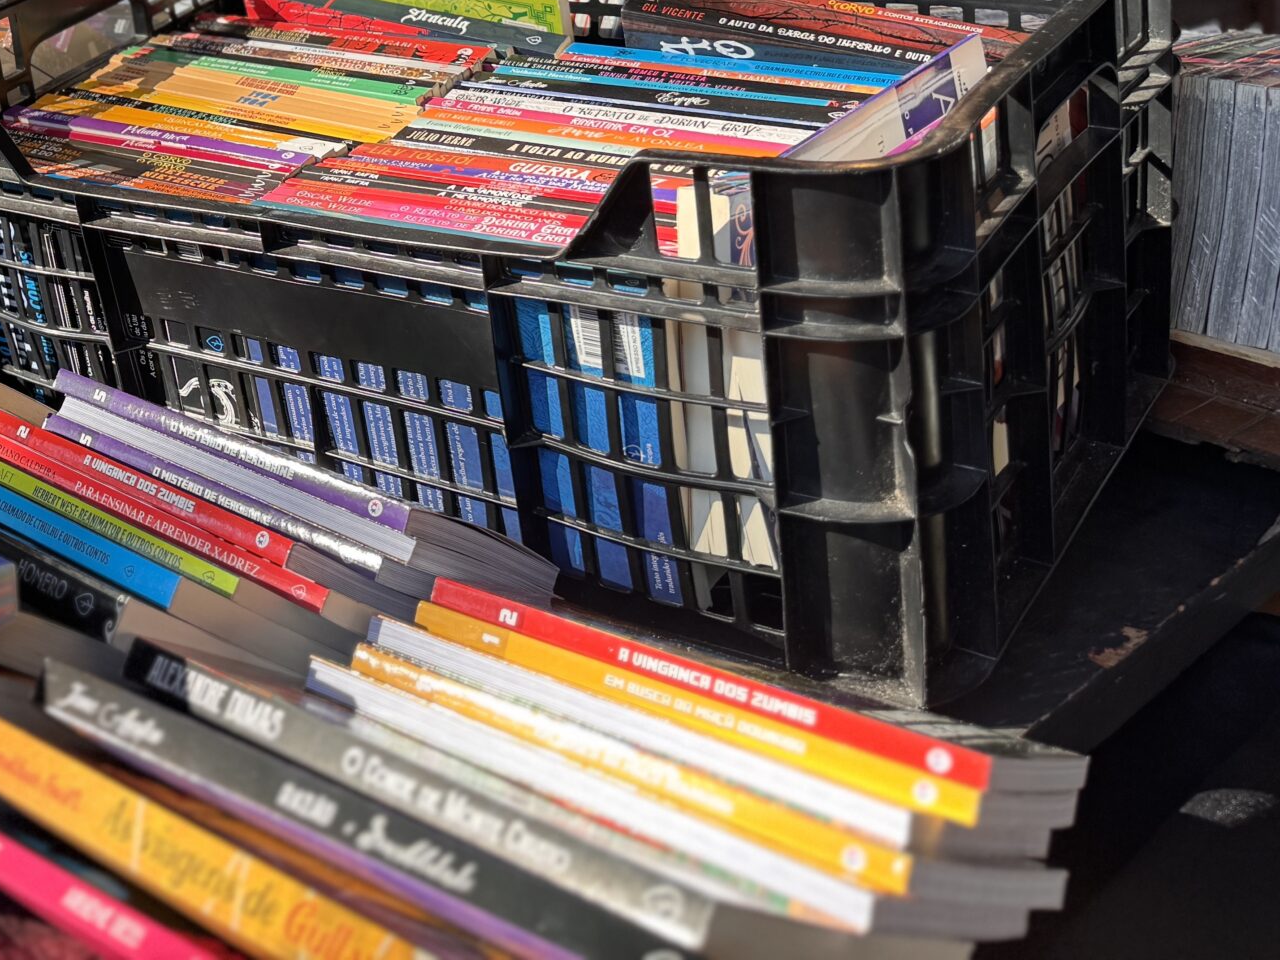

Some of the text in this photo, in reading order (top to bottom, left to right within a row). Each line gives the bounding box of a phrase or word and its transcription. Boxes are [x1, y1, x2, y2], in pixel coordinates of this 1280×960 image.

[400, 7, 471, 36] Dracula
[835, 3, 875, 16] CORVO
[885, 11, 912, 22] CONTOS
[641, 2, 659, 14] GIL
[661, 7, 706, 22] VICENTE
[727, 19, 756, 31] AUTO
[758, 23, 774, 32] DA
[817, 35, 835, 45] DO
[836, 37, 891, 55] INFERNO
[499, 60, 530, 68] WILLIAM
[531, 63, 585, 74] SHAKESPEARE
[598, 71, 628, 79] SONHO
[559, 61, 614, 72] SHAKESPEARE
[628, 68, 660, 77] ROMEU
[669, 73, 707, 82] JULIETA
[572, 54, 641, 68] Lewis Carroll
[490, 97, 524, 107] WILDE
[574, 106, 635, 122] RETRATO
[653, 112, 710, 131] DORIAN
[570, 117, 629, 134] RINKITINK
[630, 124, 648, 136] EM
[651, 127, 675, 139] OZ
[408, 129, 584, 160] JÚLIO VERNE A VOLTA AO
[626, 136, 704, 150] AVONLEA
[153, 154, 192, 165] CORVO
[372, 144, 405, 158] LIEV
[408, 149, 475, 165] TOLSTÓI
[509, 162, 591, 180] GUERRA
[142, 171, 220, 190] NIETZSCHE
[286, 197, 324, 208] OSCAR
[327, 202, 363, 213] WILDE
[470, 223, 530, 238] DORIAN
[296, 190, 332, 201] OSCAR
[338, 196, 374, 206] WILDE
[412, 206, 460, 219] RETRATO
[482, 216, 539, 230] DORIAN
[179, 423, 222, 450] MISTÉRIO
[83, 454, 92, 465] A
[137, 478, 158, 493] DOS
[158, 487, 196, 513] ZUMBIS
[161, 471, 204, 497] MISTÉRIO
[20, 454, 57, 479] CALDEIRA
[74, 481, 98, 502] PARA
[100, 493, 145, 521] ENSINAR
[154, 518, 210, 554] APRENDER
[210, 543, 260, 577] XADREZ
[32, 485, 61, 507] HERBERT
[60, 497, 81, 515] WEST:
[79, 508, 121, 538] REANIMATOR
[126, 532, 155, 554] OUTROS
[154, 544, 184, 568] CONTOS
[1, 500, 27, 522] CHAMADO
[33, 517, 60, 540] CTHULHU
[64, 533, 87, 553] OUTROS
[85, 544, 111, 564] CONTOS
[20, 559, 68, 600] HOMERO
[653, 571, 663, 590] Texto
[663, 563, 675, 594] traduzido
[604, 673, 672, 708] EM BUSCA
[618, 647, 629, 662] A
[714, 679, 749, 703] DOS
[749, 690, 817, 726] ZUMBIS
[147, 654, 228, 714] ALEXANDRE
[223, 687, 287, 739] DUMAS
[341, 745, 365, 775] O
